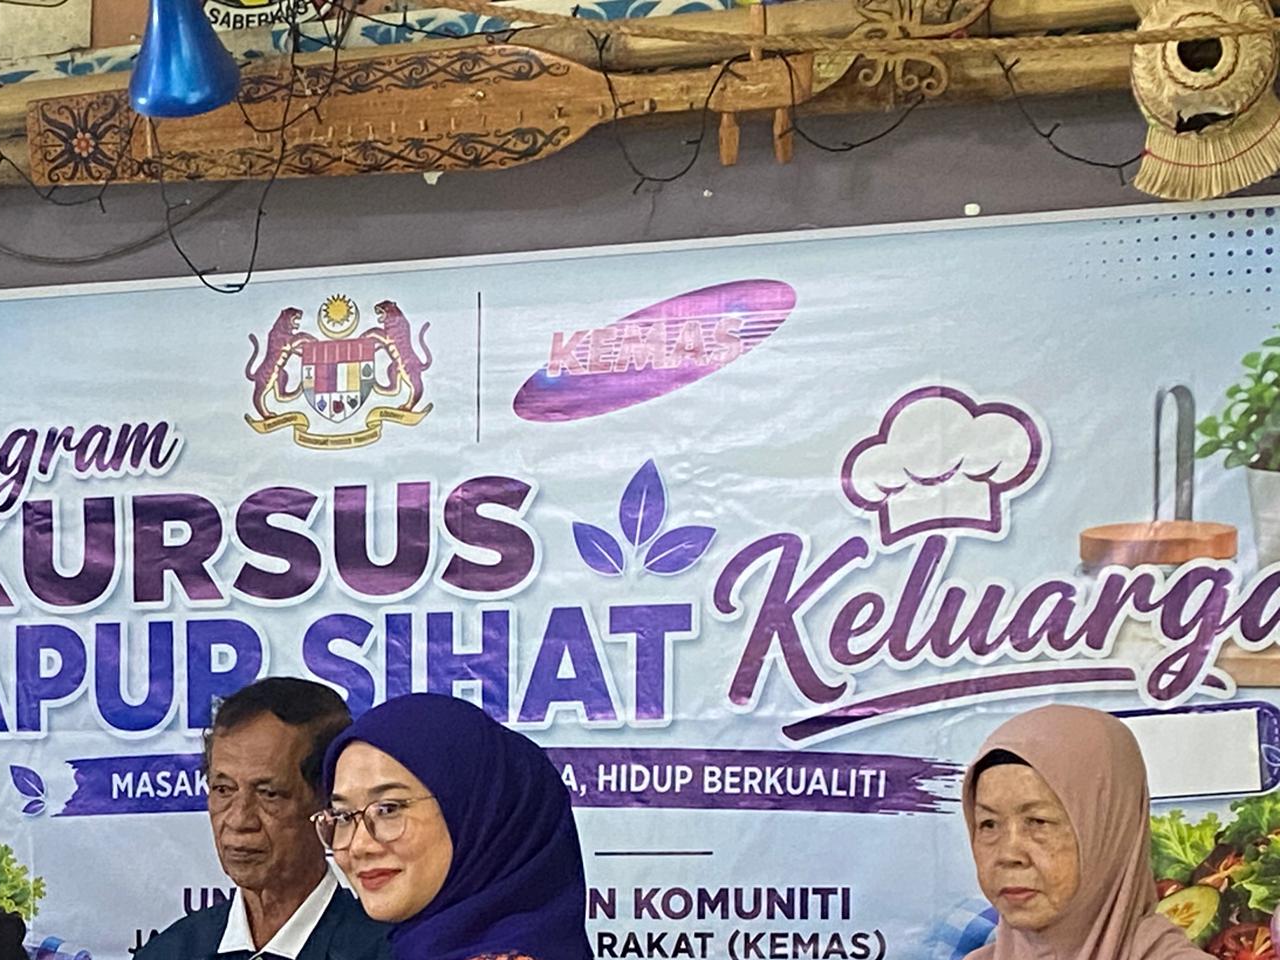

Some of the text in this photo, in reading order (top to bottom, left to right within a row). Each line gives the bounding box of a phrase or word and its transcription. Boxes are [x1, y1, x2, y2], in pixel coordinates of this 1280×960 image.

[547, 317, 745, 378] KEMAS
[303, 602, 693, 724] SIHAT
[598, 764, 693, 794] HIDUP
[703, 766, 887, 798] BERKUALITI
[633, 886, 851, 921] KOMUNITI
